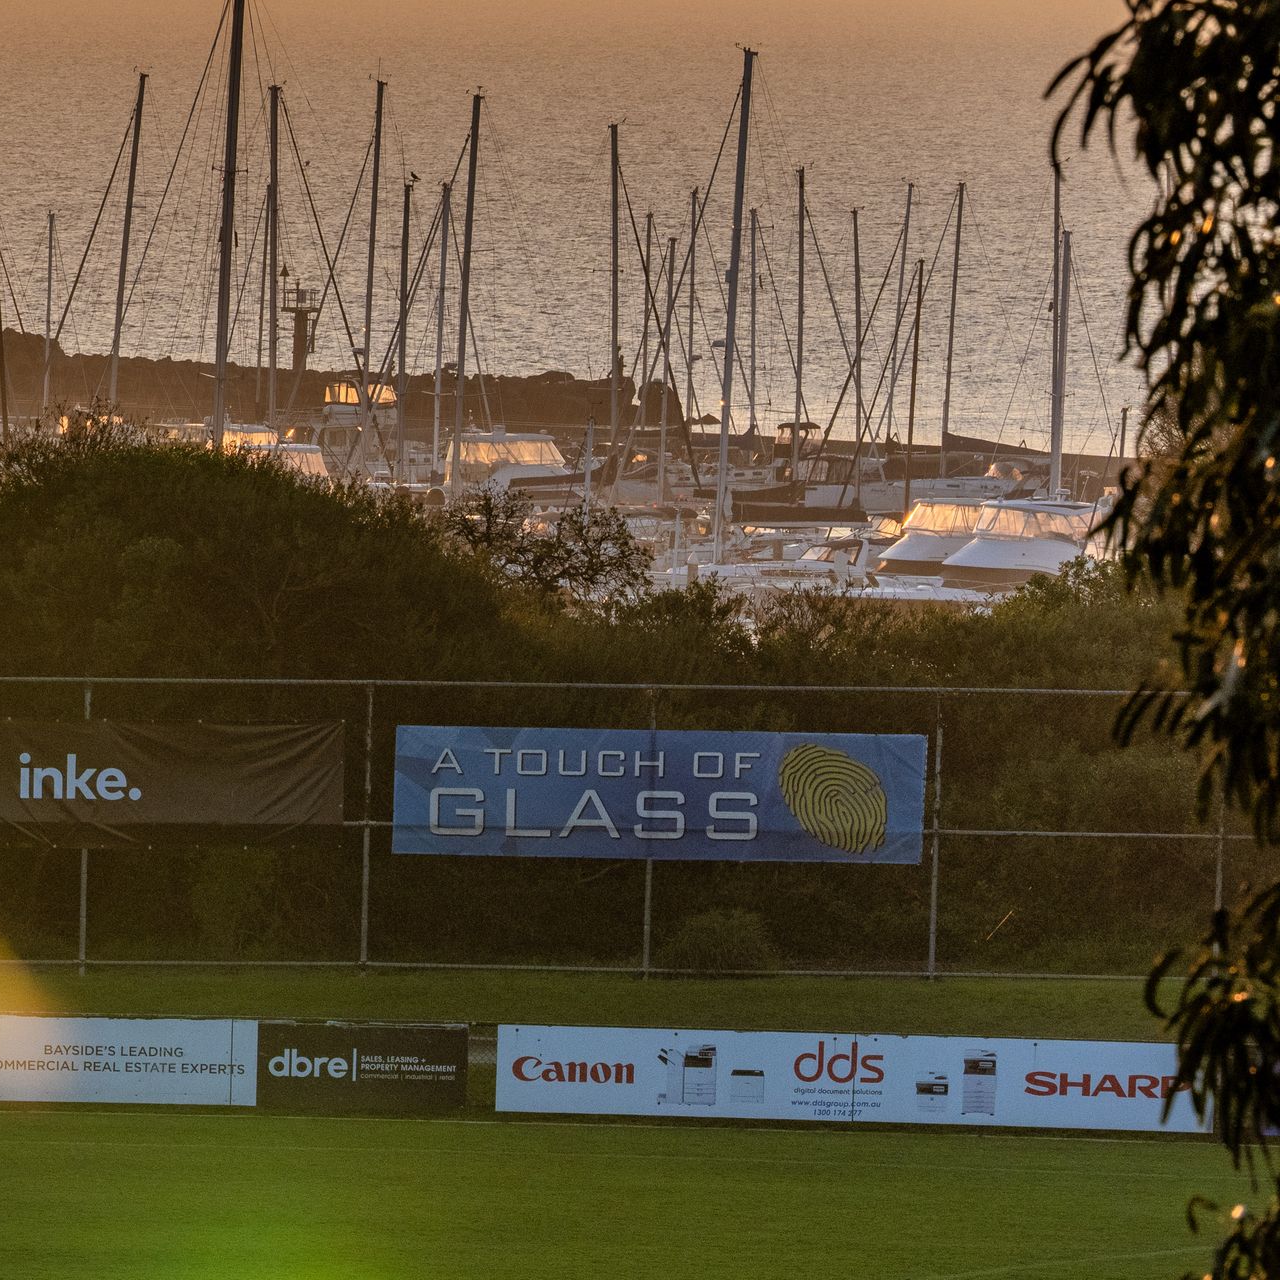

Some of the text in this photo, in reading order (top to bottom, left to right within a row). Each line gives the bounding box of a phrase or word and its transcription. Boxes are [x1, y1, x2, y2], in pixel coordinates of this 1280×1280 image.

[431, 748, 762, 779] A TOUCH OF
[18, 752, 142, 802] inke.
[429, 786, 758, 841] GLASS
[44, 1044, 184, 1058] BAYSIDE'S LEADING
[387, 1055, 419, 1064] LEASING
[83, 1061, 121, 1073] REAL
[126, 1062, 177, 1074] ESTATE
[182, 1063, 245, 1075] EXPERTS
[268, 1048, 348, 1079] dbre
[361, 1063, 457, 1072] PROPERTY MANAGEMENT
[512, 1056, 635, 1084] Canon
[793, 1041, 885, 1084] dds
[793, 1087, 817, 1095] digital
[1024, 1071, 1191, 1099] SHARP
[791, 1100, 881, 1108] www.ddsgroup.com.au
[833, 1109, 846, 1117] 174
